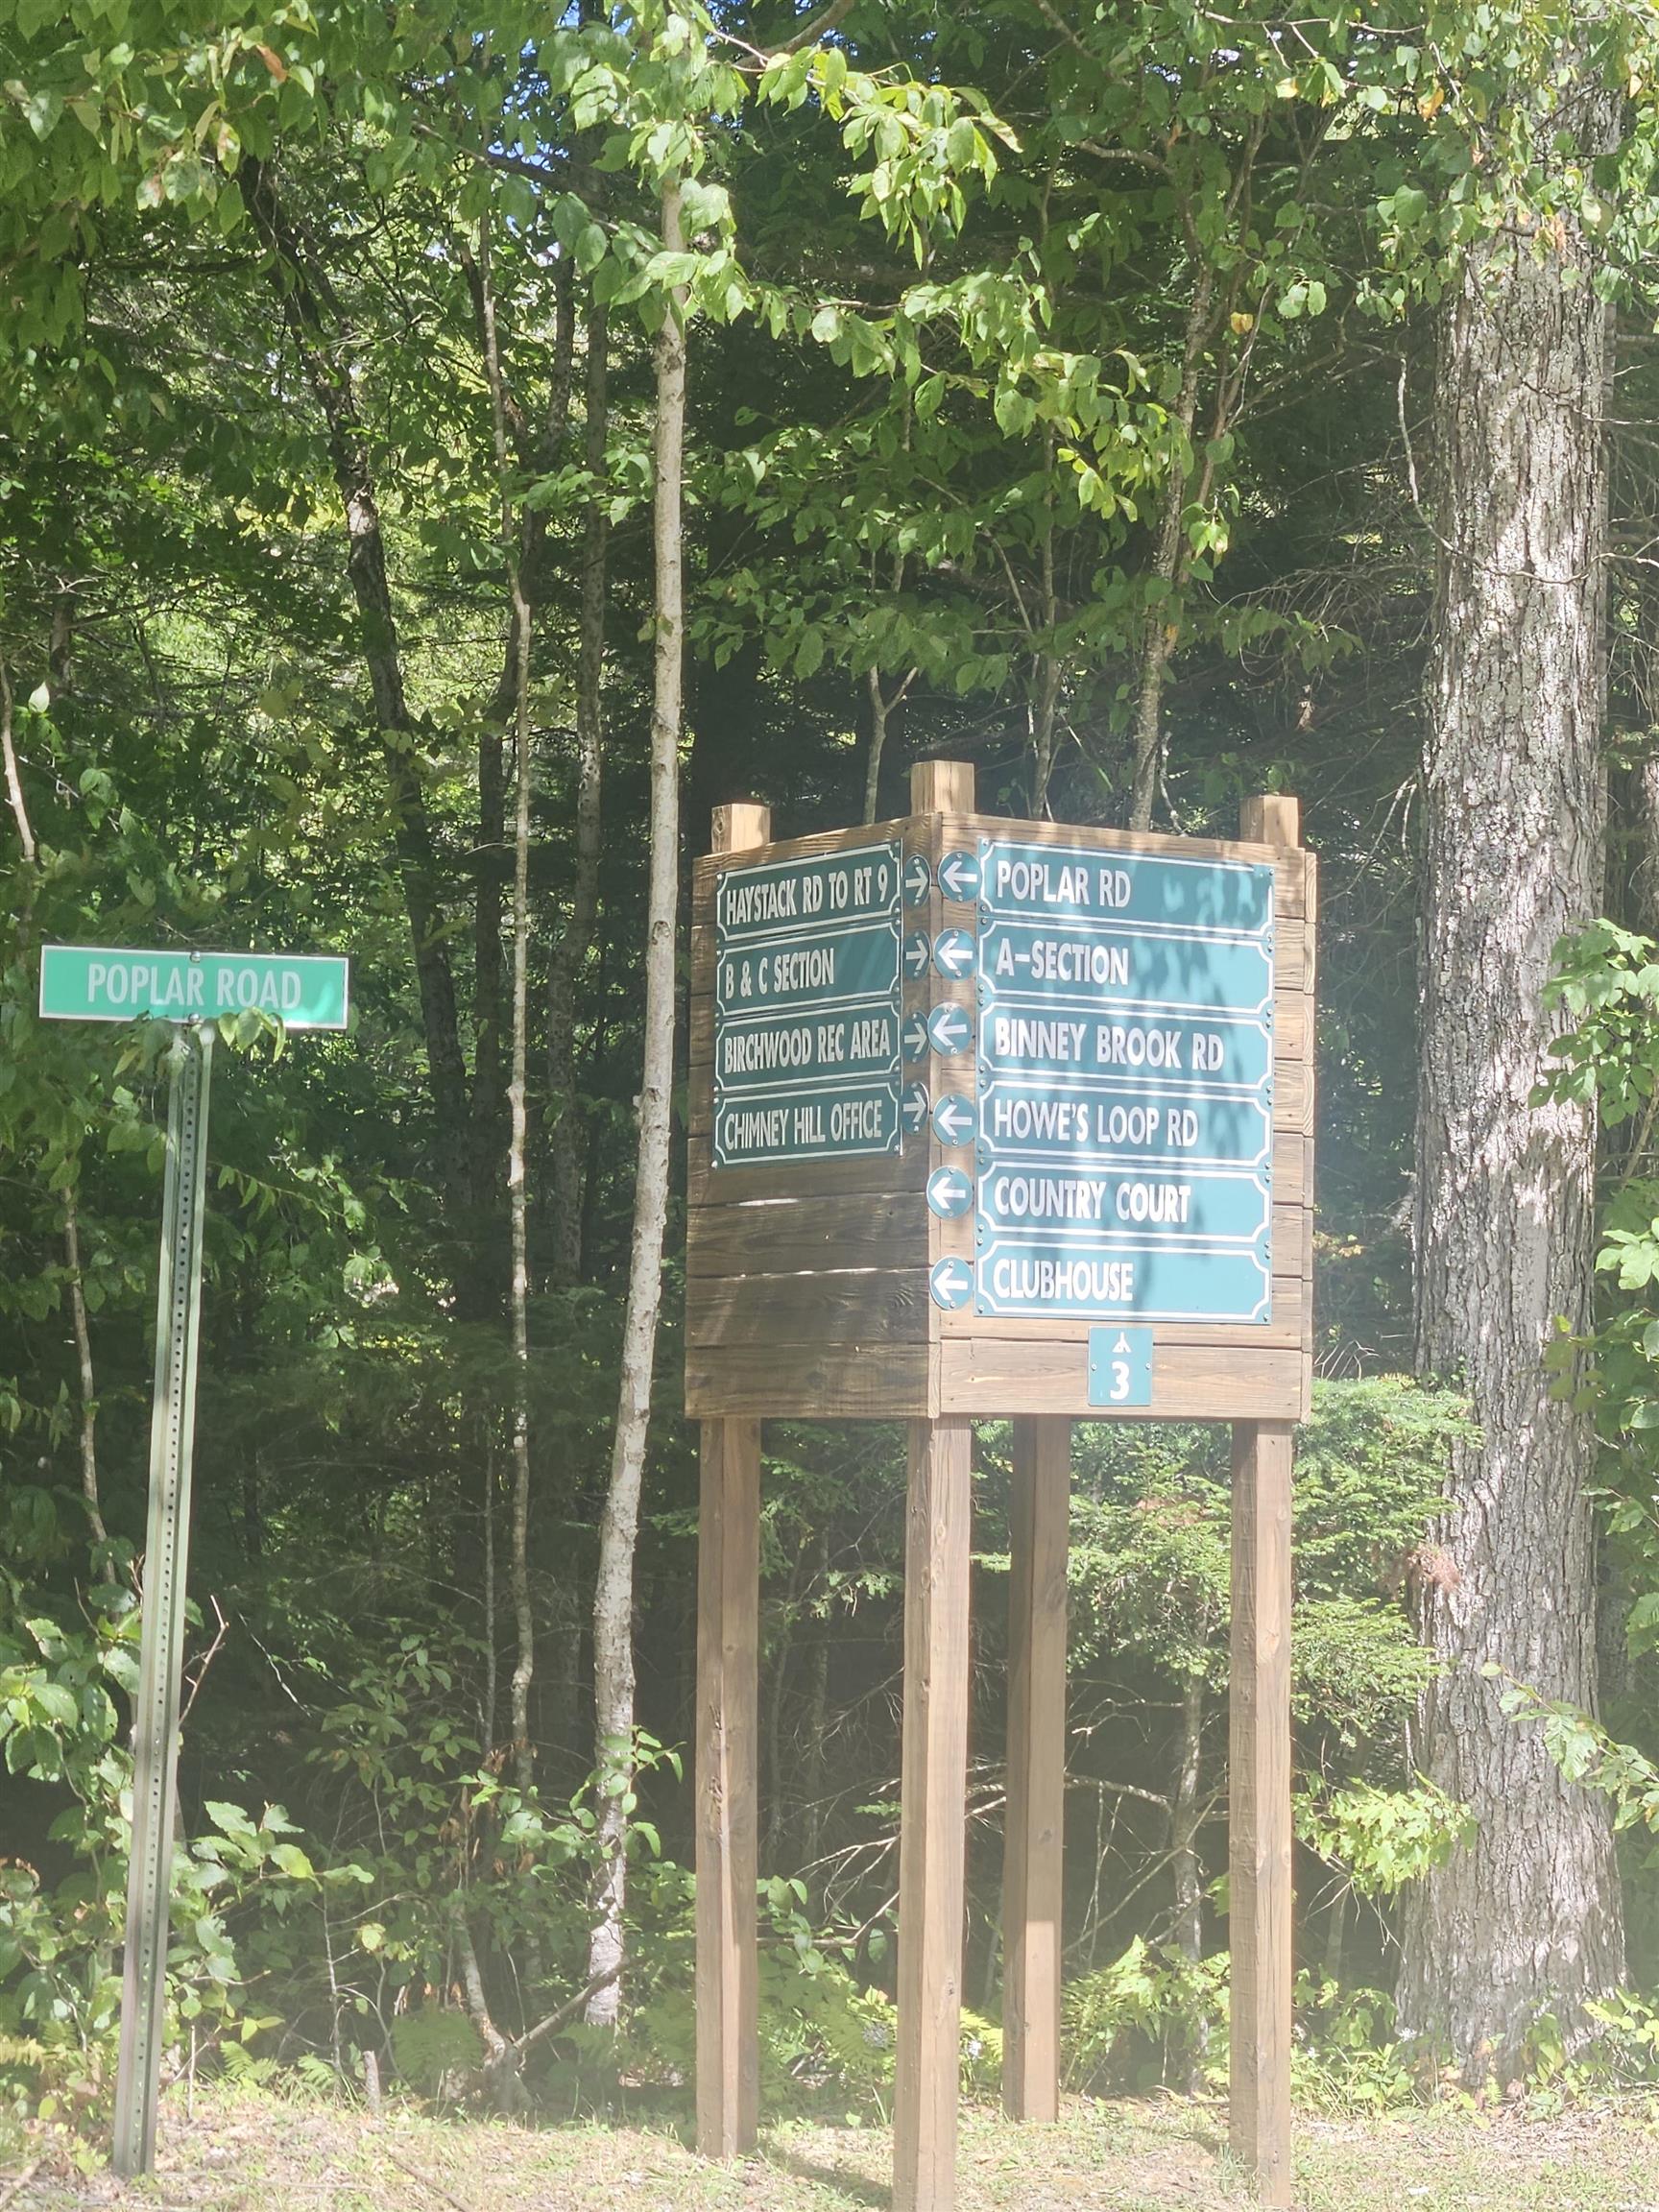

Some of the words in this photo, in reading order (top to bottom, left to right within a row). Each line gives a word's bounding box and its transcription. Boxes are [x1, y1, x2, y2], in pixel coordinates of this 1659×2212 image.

[727, 879, 796, 926] HAYSTACK
[803, 877, 823, 913] RD
[829, 871, 848, 909] TO
[854, 867, 872, 905] RT
[878, 864, 887, 902] 9
[998, 861, 1090, 905] POPLAR
[1099, 869, 1131, 907] RD
[726, 963, 733, 998] B
[740, 961, 751, 996] &
[758, 957, 768, 995] C
[774, 949, 833, 993] SECTION
[996, 938, 1129, 985] A-SECTION
[87, 963, 204, 1006] POPLAR
[217, 969, 301, 1009] ROAD
[725, 1028, 811, 1073] BIRCHWOOD
[818, 1022, 844, 1063] REC
[850, 1020, 890, 1061] AREA
[995, 1017, 1086, 1063] BINNEY
[1097, 1026, 1182, 1070] BROOK
[1192, 1033, 1223, 1071] RD
[725, 1109, 788, 1150] CHIMNEY
[794, 1105, 825, 1144] HILL
[830, 1100, 882, 1142] OFFICE
[994, 1099, 1089, 1143] HOWE'S
[1097, 1104, 1158, 1145] LOOP
[1166, 1109, 1197, 1147] RD
[995, 1177, 1106, 1219] COUNTRY
[1116, 1183, 1190, 1223] COURT
[994, 1259, 1133, 1302] CLUBHOUSE
[1110, 1361, 1130, 1401] 3
